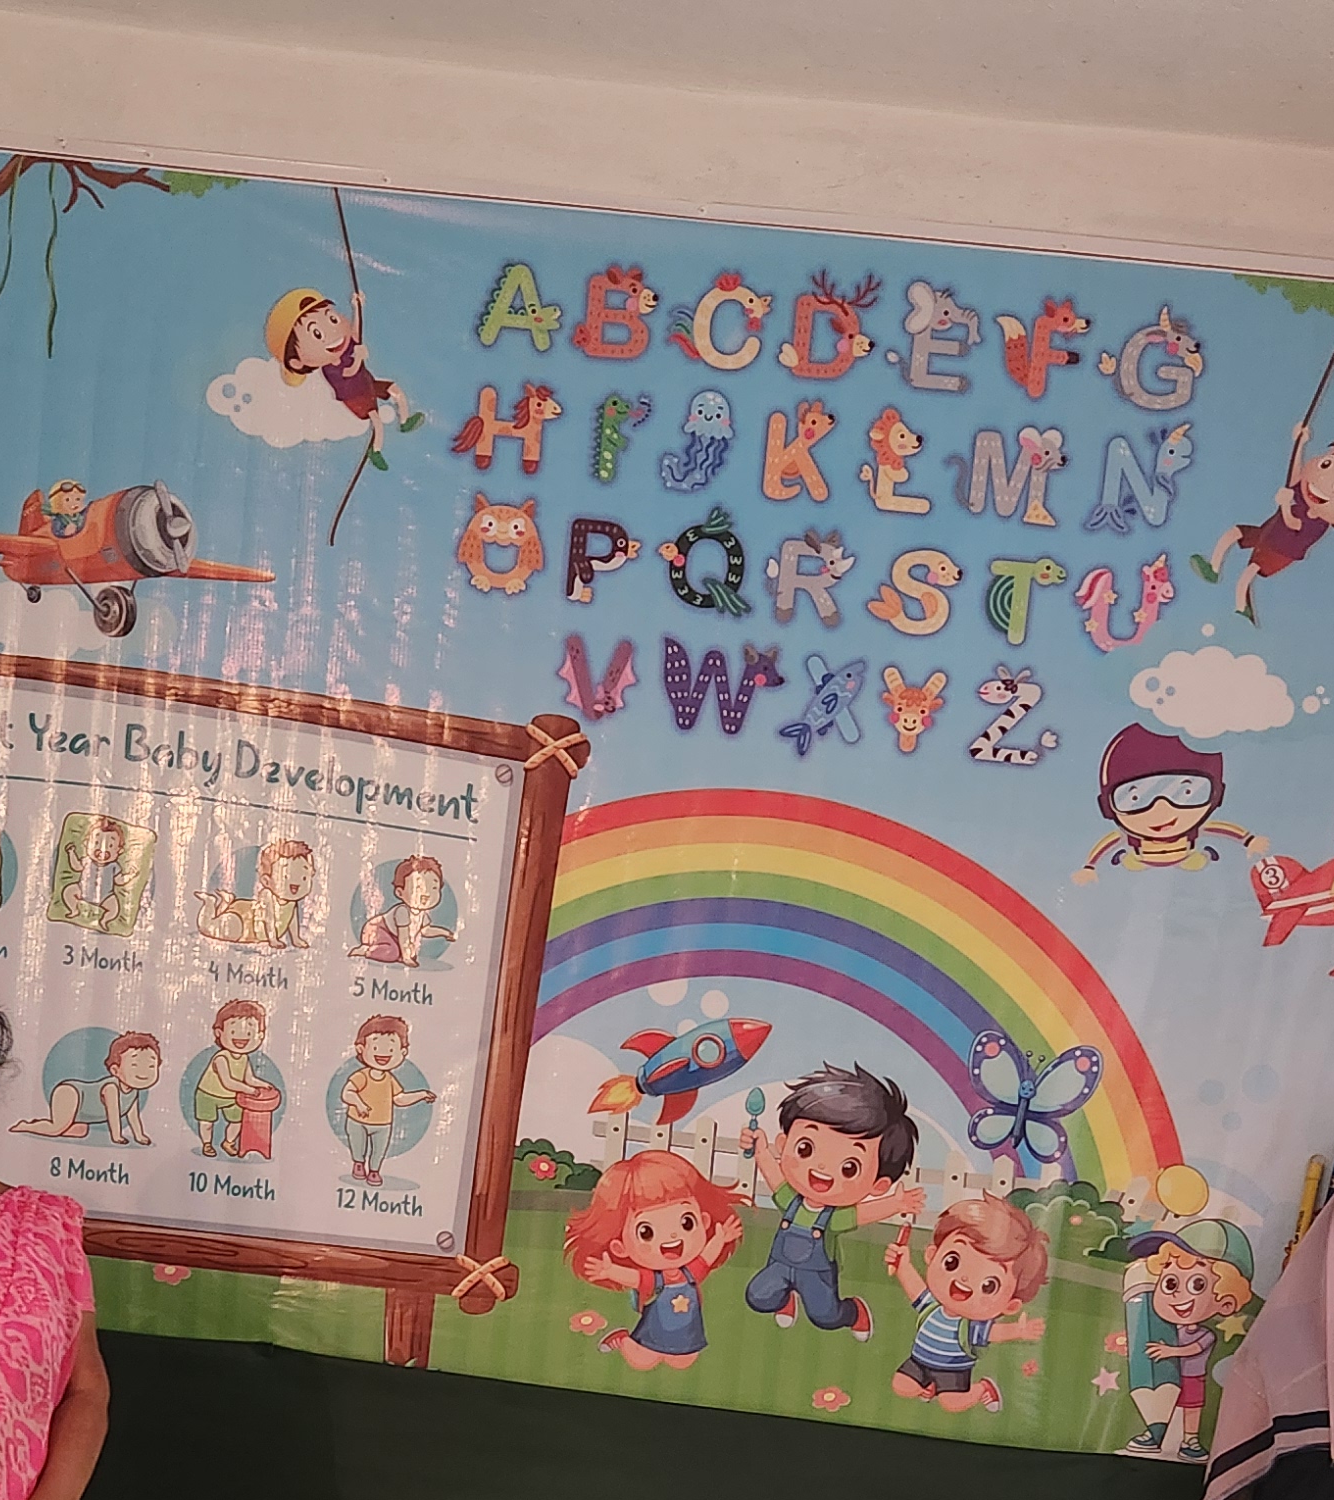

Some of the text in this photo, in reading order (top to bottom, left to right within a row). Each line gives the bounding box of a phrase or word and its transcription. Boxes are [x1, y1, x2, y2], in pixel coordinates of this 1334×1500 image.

[29, 714, 111, 756] Year
[125, 724, 222, 788] Baby
[235, 741, 479, 825] Development
[1267, 868, 1279, 885] 3
[63, 944, 143, 974] 3 Month
[208, 960, 288, 991] 4 Month
[353, 978, 433, 1006] 5 Month
[49, 1159, 129, 1186] 8 Month
[189, 1172, 275, 1202] 10 Month
[337, 1188, 423, 1219] 12 Month
